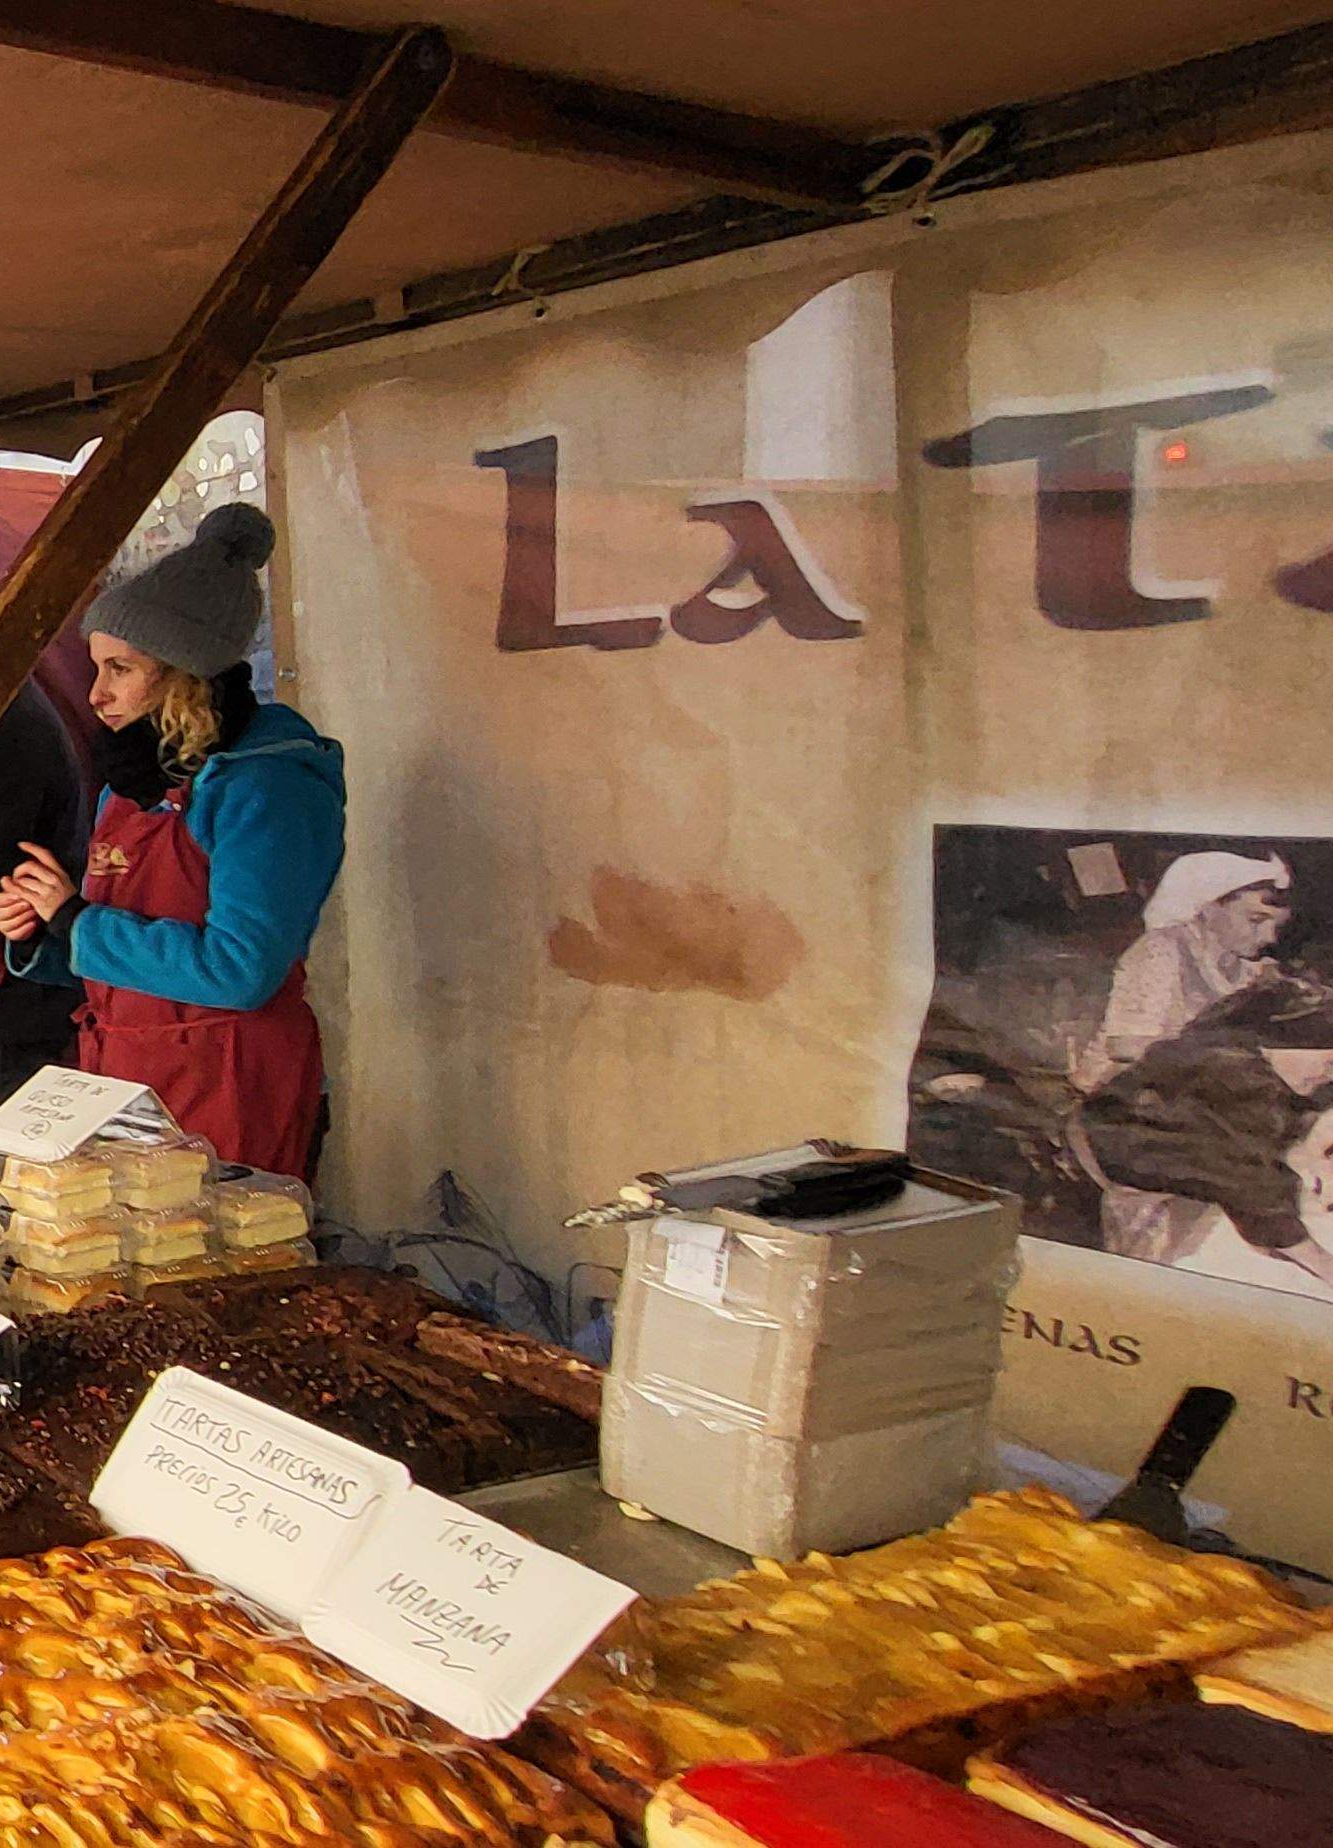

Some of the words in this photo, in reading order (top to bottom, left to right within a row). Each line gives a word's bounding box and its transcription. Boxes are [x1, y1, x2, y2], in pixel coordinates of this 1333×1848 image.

[472, 433, 866, 653] La
[921, 382, 1333, 632] T
[158, 1396, 252, 1453] TARTAS
[249, 1440, 358, 1505] ARTESANAS
[436, 1518, 524, 1579] TARTA
[474, 1574, 509, 1596] DE
[375, 1572, 512, 1656] MANZANA
